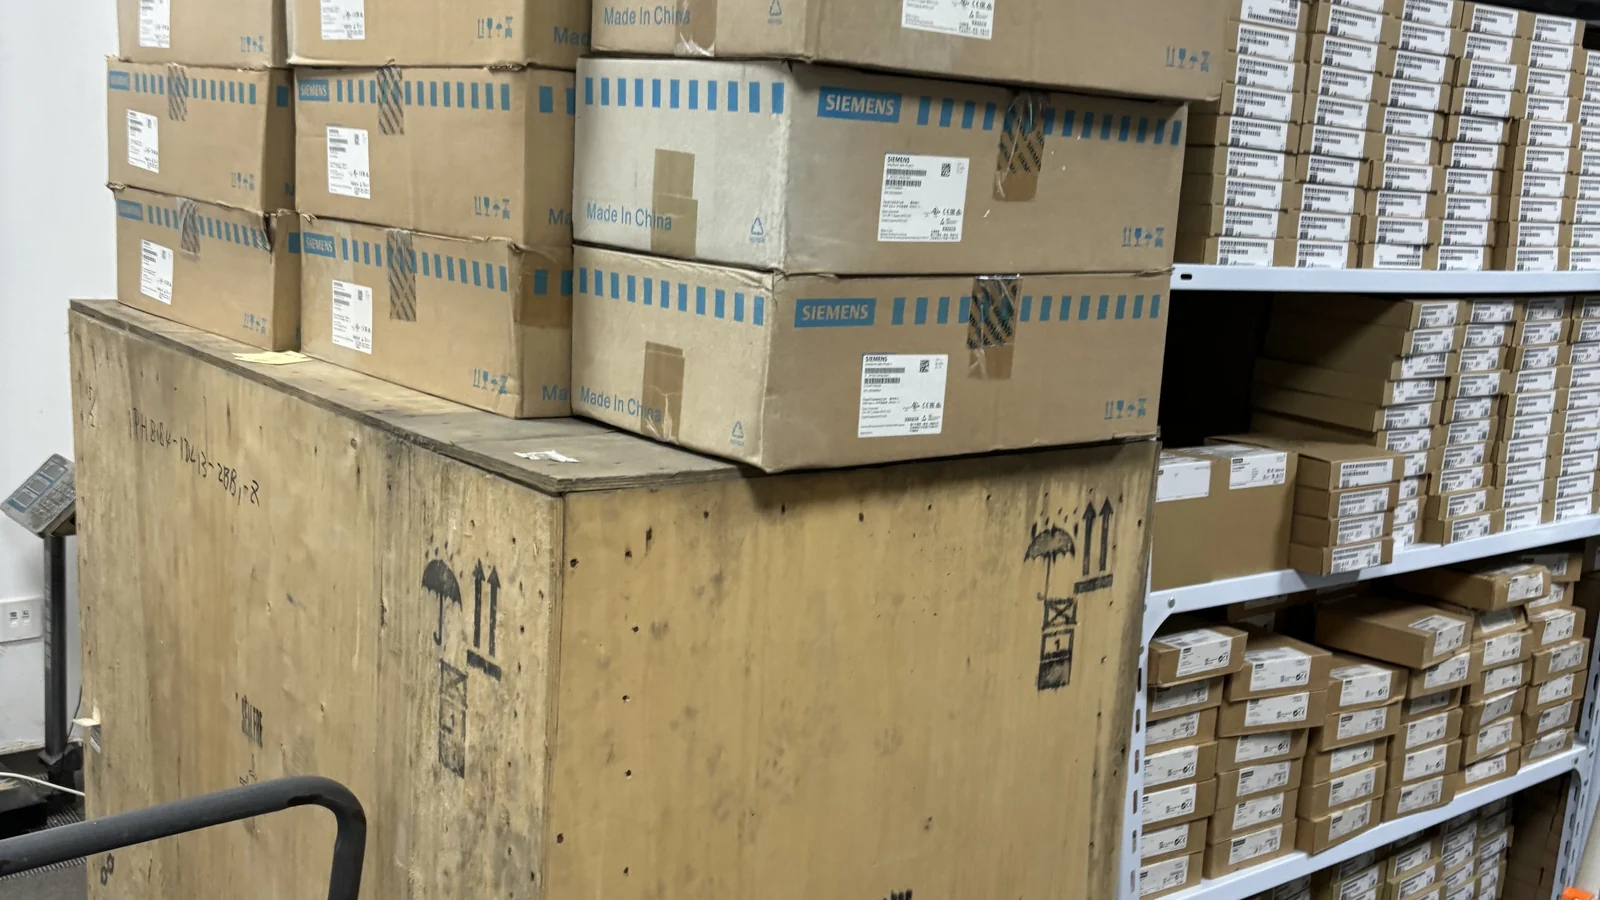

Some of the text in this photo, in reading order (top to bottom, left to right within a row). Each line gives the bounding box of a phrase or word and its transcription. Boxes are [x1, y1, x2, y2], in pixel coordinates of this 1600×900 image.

[603, 6, 690, 25] Made In China
[825, 94, 895, 116] SIEMENS
[887, 156, 910, 164] SIEMENS
[586, 202, 672, 231] Made In China
[802, 304, 869, 321] SIEMENS
[580, 386, 661, 423] Made In China
